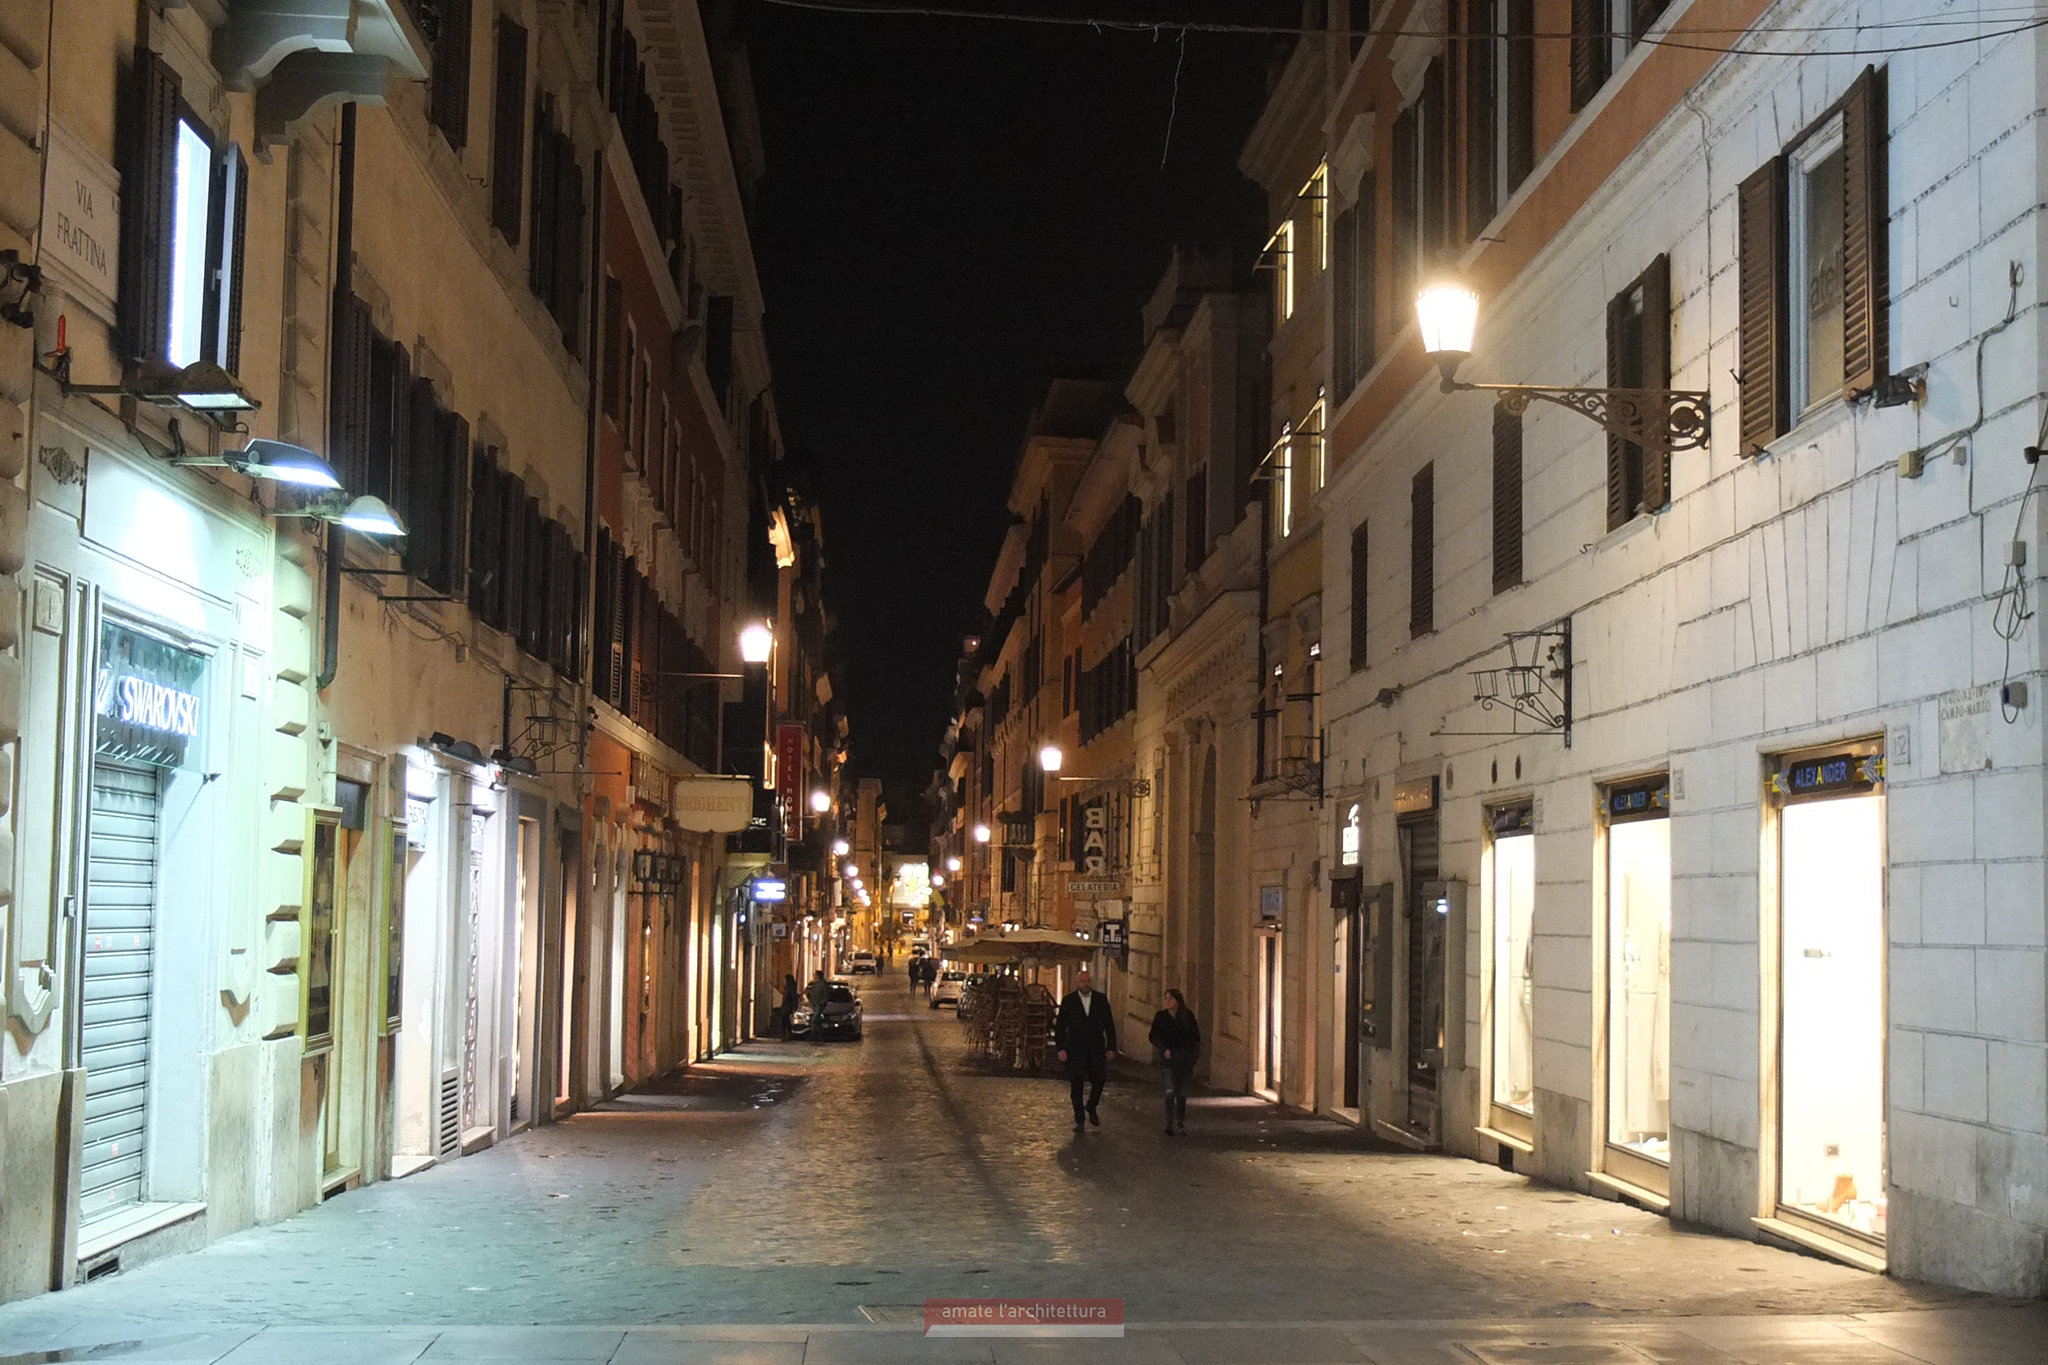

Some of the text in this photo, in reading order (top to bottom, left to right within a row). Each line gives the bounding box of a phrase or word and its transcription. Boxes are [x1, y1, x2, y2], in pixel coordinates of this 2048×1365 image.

[76, 180, 94, 219] VIA
[57, 211, 107, 276] FRATTINA
[123, 675, 200, 737] SWAROVSKI
[787, 737, 795, 781] HOTEL
[1794, 761, 1847, 789] ALEXANDER
